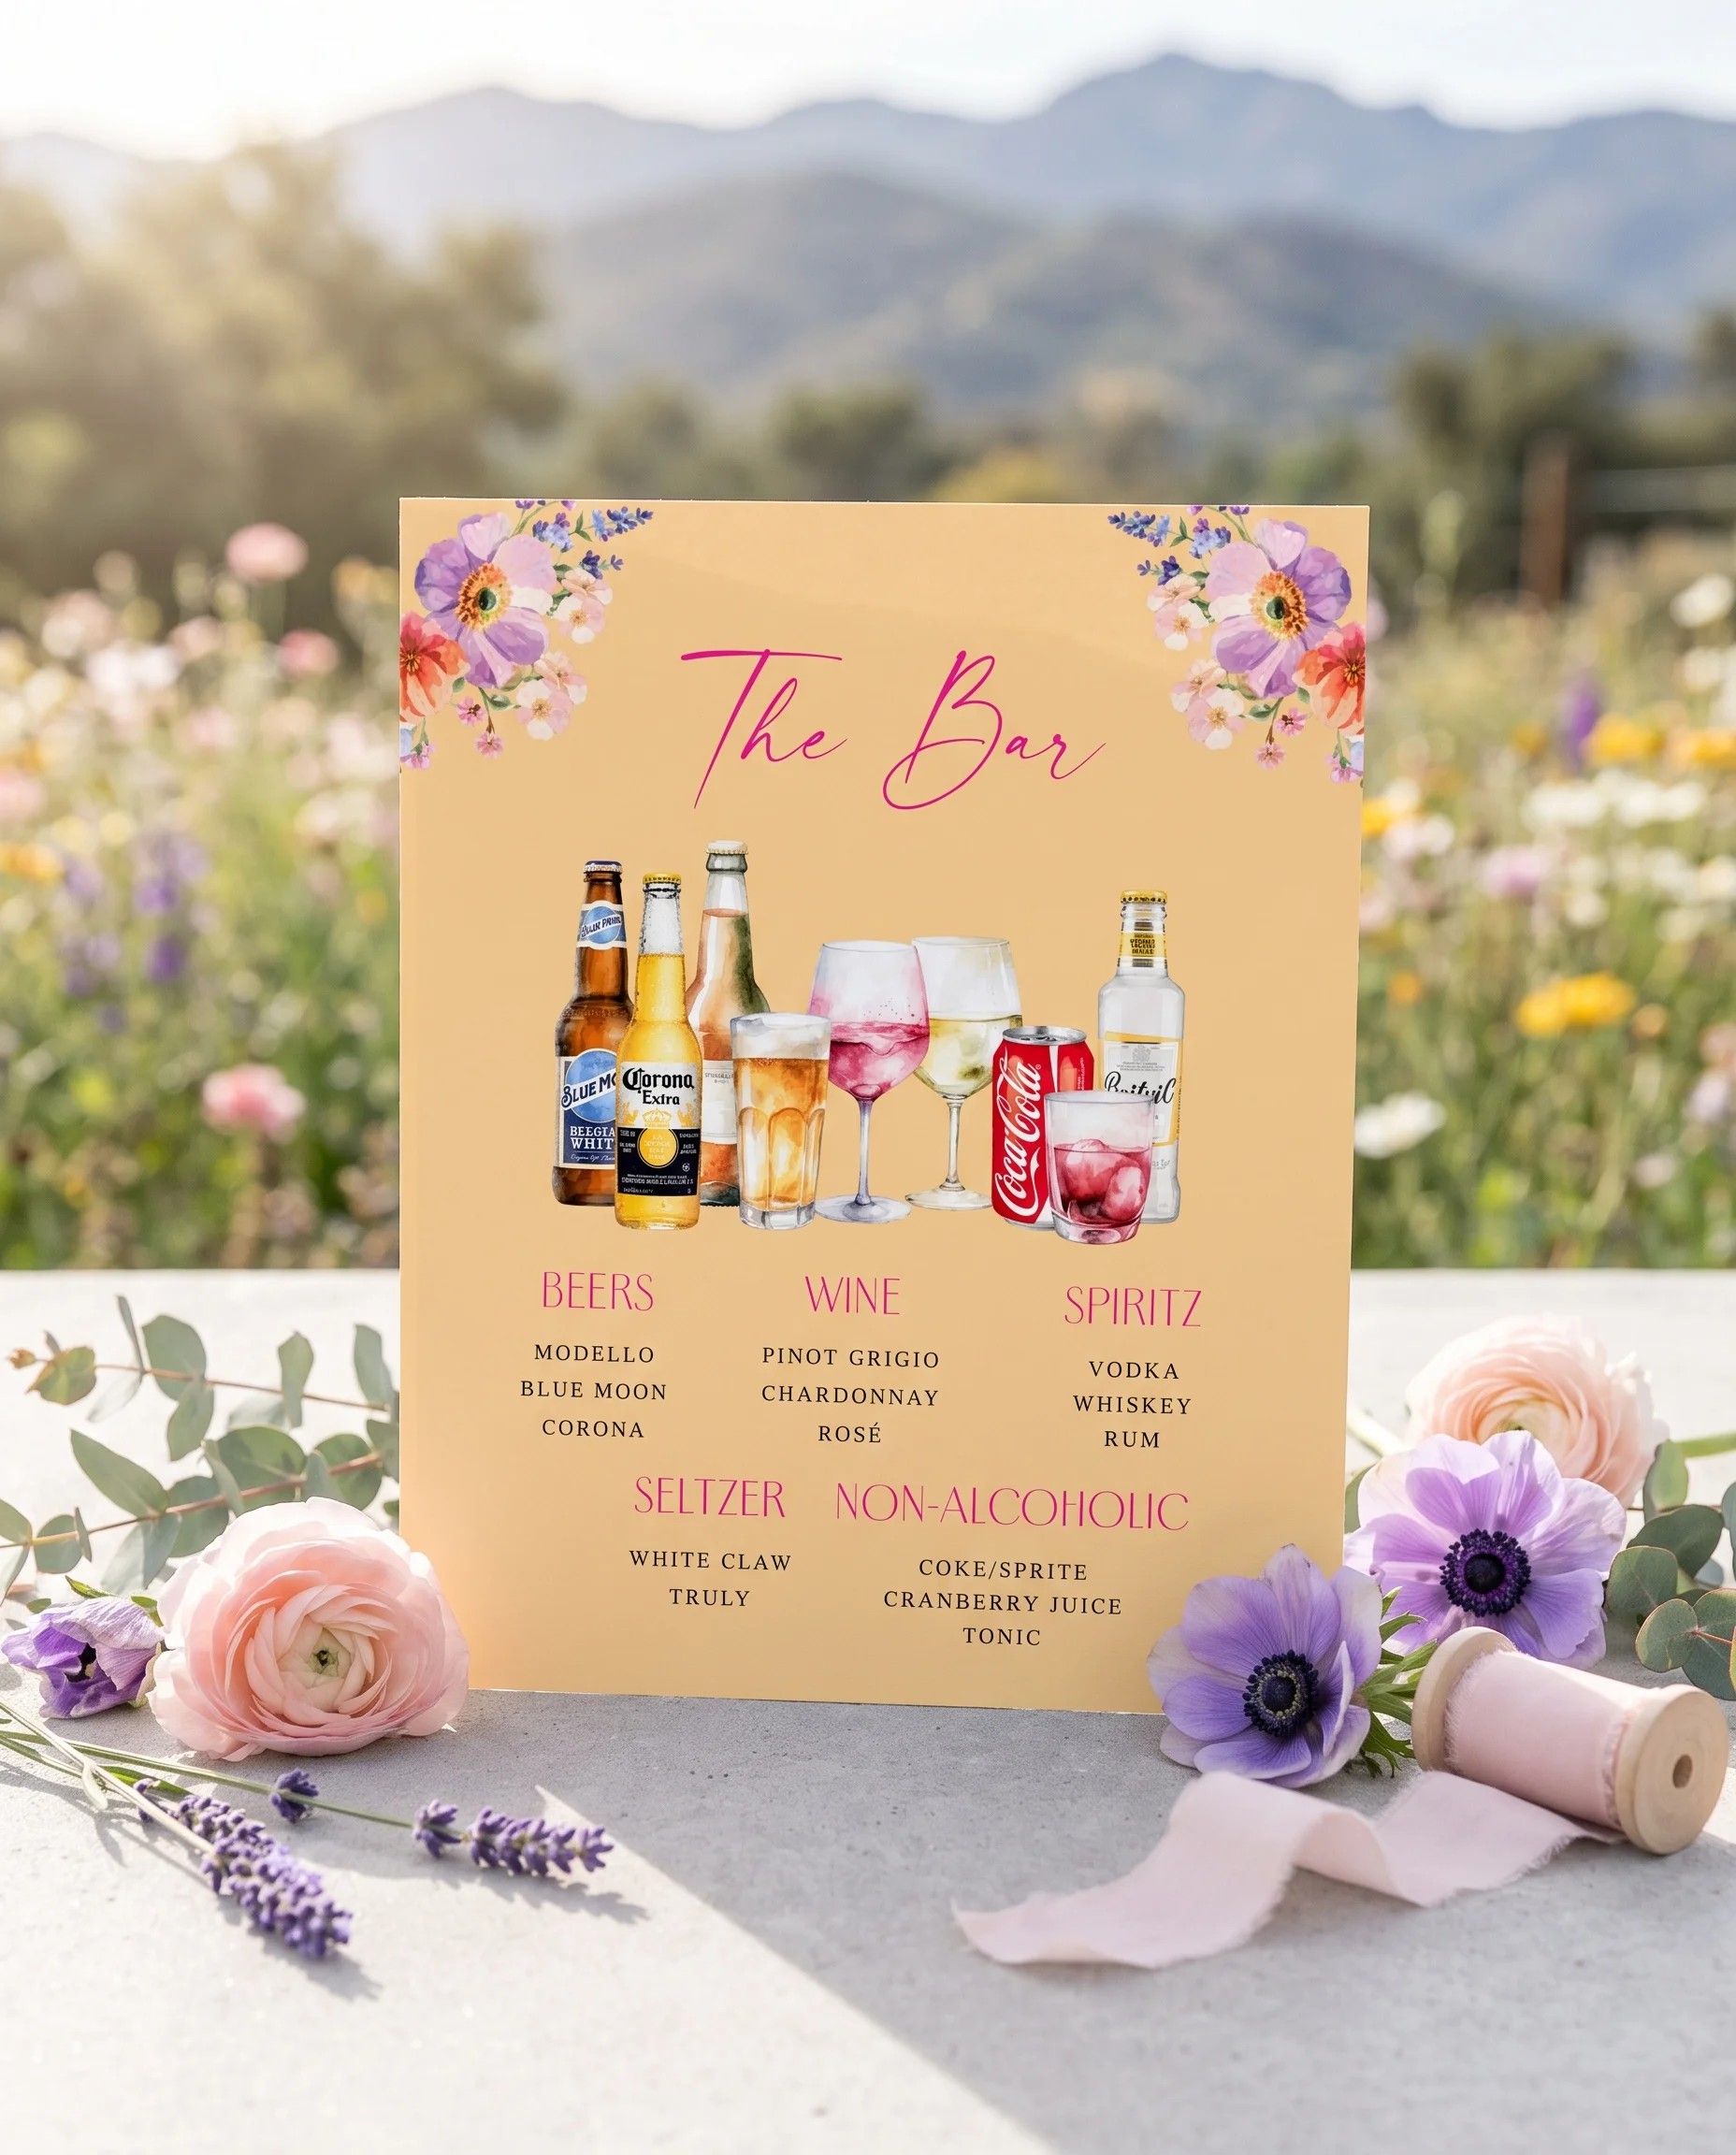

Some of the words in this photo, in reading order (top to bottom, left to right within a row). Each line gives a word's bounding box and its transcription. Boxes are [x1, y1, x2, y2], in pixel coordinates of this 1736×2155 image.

[680, 648, 848, 809] The
[882, 650, 1107, 810] Bar
[622, 1067, 695, 1091] Corona
[561, 1079, 597, 1107] BLUE
[642, 1090, 680, 1106] Extra
[570, 1125, 615, 1137] BEEGIA
[570, 1136, 615, 1150] WHIT
[542, 1271, 654, 1311] BEERS
[804, 1276, 901, 1315] WINE
[1064, 1286, 1202, 1327] SPIRITZ
[534, 1343, 654, 1364] MODELLO
[762, 1347, 838, 1366] PINOT
[848, 1349, 939, 1369] GRIGIO
[1088, 1360, 1179, 1380] VODKA
[520, 1380, 584, 1398] BLUE
[594, 1381, 667, 1400] MOON
[761, 1384, 939, 1407] CHARDONNAY
[1072, 1395, 1192, 1415] WHISKEY
[542, 1419, 644, 1439] CORONA
[817, 1421, 881, 1443] ROSÉ
[1104, 1430, 1160, 1449] RUM
[634, 1476, 786, 1518] SELTZER
[836, 1482, 1189, 1531] NON-ALCOHOLIC
[629, 1550, 710, 1569] WHITE
[721, 1553, 791, 1571] CLAW
[919, 1558, 1088, 1581] COKE/SPRITE
[669, 1588, 751, 1607] TRULY
[883, 1590, 1039, 1613] CRANBERRY
[1049, 1596, 1121, 1615] JUICE
[962, 1627, 1040, 1646] TONIC
